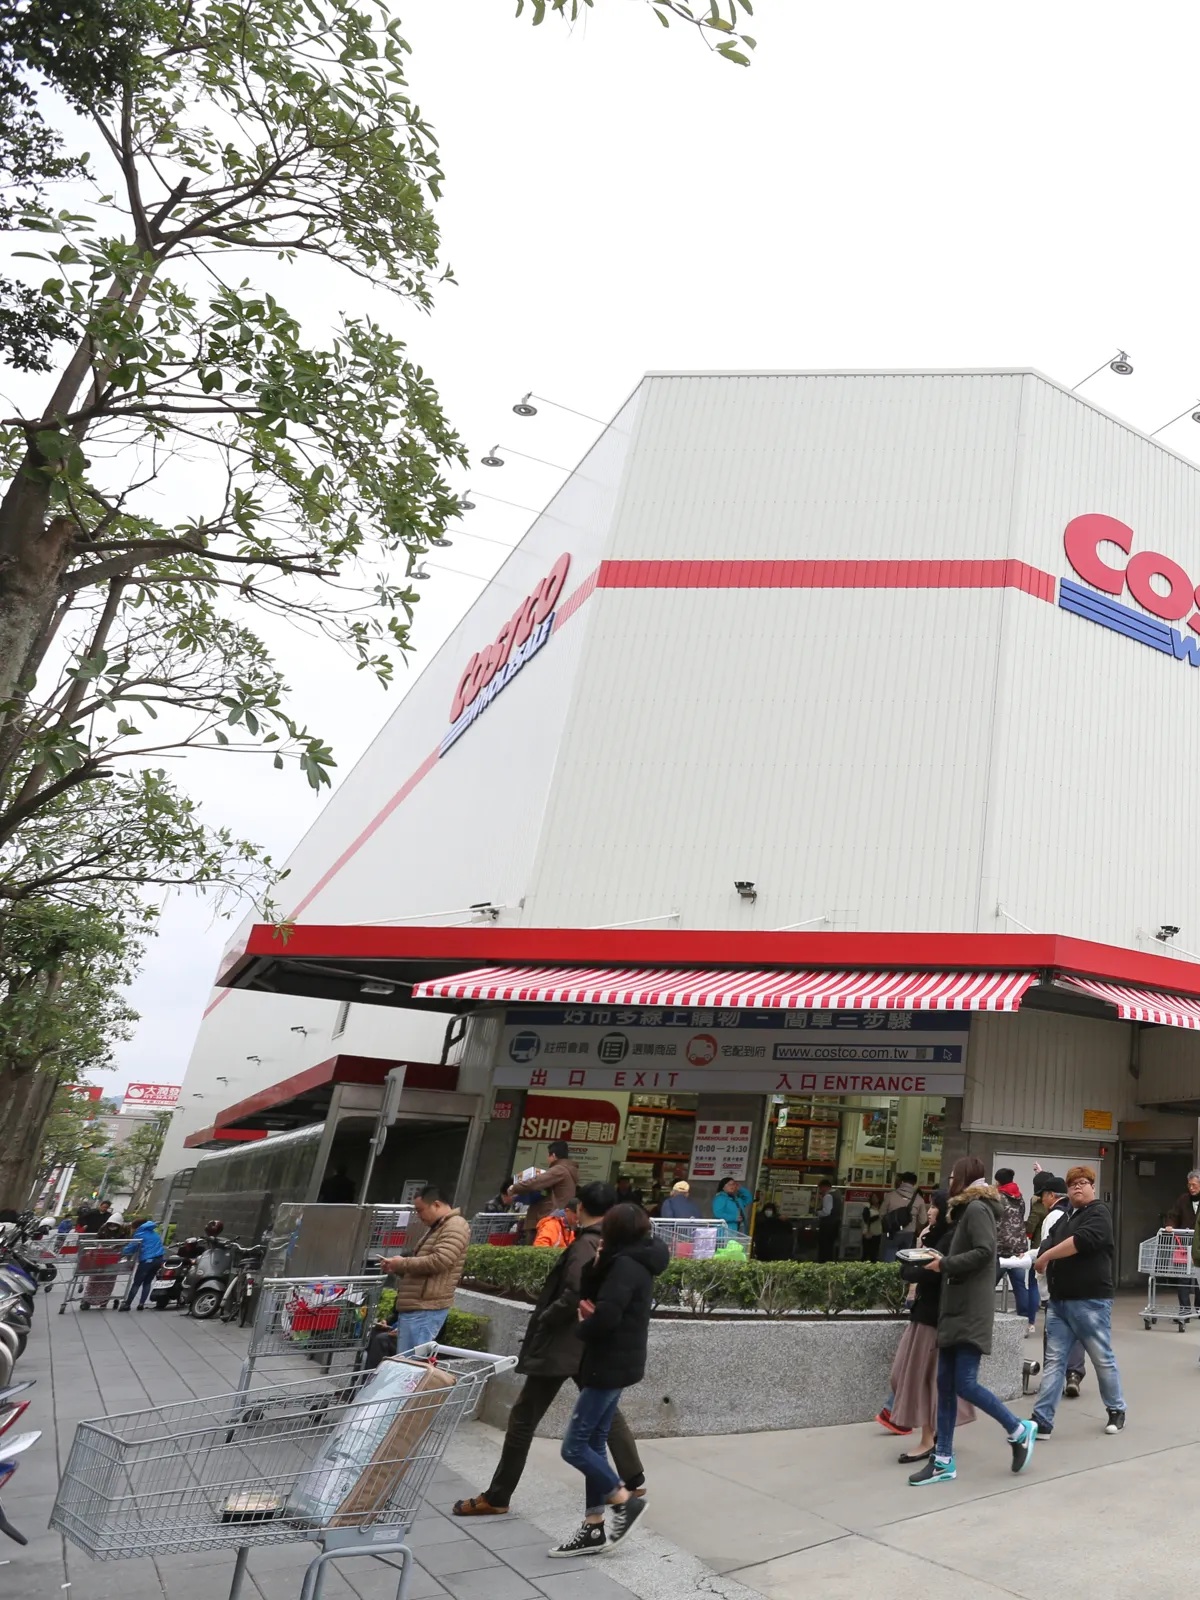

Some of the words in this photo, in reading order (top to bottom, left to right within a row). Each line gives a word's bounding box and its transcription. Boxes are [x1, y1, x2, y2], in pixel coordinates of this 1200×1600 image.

[449, 552, 570, 724] COSTCO
[720, 1045, 766, 1058] 宅配到府
[778, 1046, 908, 1060] www.costco.com.tw
[530, 1068, 586, 1087] 出口
[614, 1071, 679, 1087] EXIT
[776, 1073, 817, 1091] 入口
[823, 1075, 926, 1092] ENTRANCE
[144, 1086, 180, 1098] 大潤發
[571, 1120, 616, 1141] 會員部
